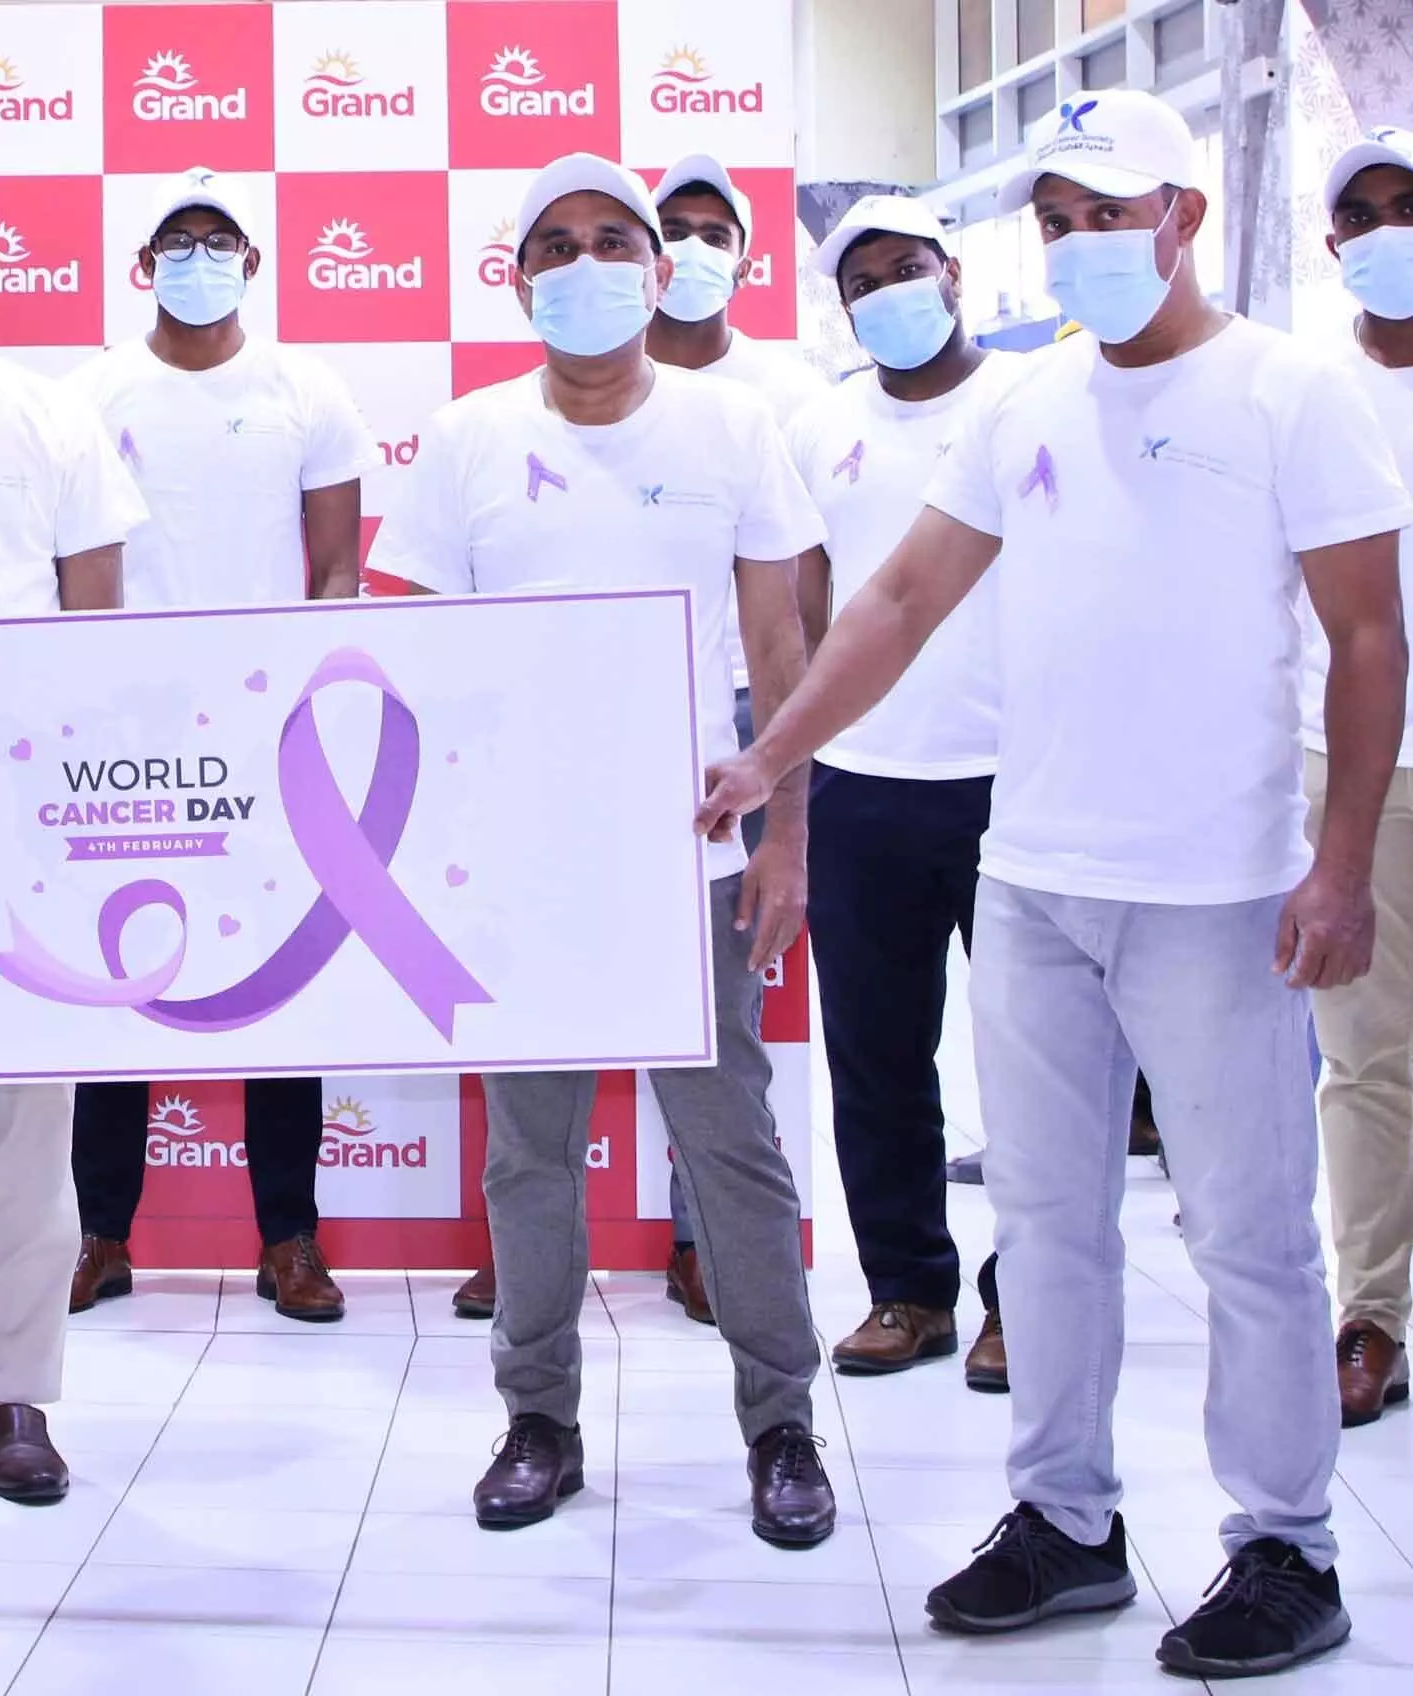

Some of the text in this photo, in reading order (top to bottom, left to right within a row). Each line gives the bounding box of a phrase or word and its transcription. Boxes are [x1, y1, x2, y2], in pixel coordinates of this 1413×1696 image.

[132, 88, 247, 121] Grand
[302, 86, 415, 118] Grand
[480, 84, 595, 116] Grand
[650, 82, 763, 114] Grand
[307, 256, 422, 290] Grand
[62, 756, 228, 792] WORLD
[38, 796, 255, 827] CANCER DAY
[87, 837, 204, 853] 4TH FEBRUARY
[317, 1135, 427, 1169] Grand
